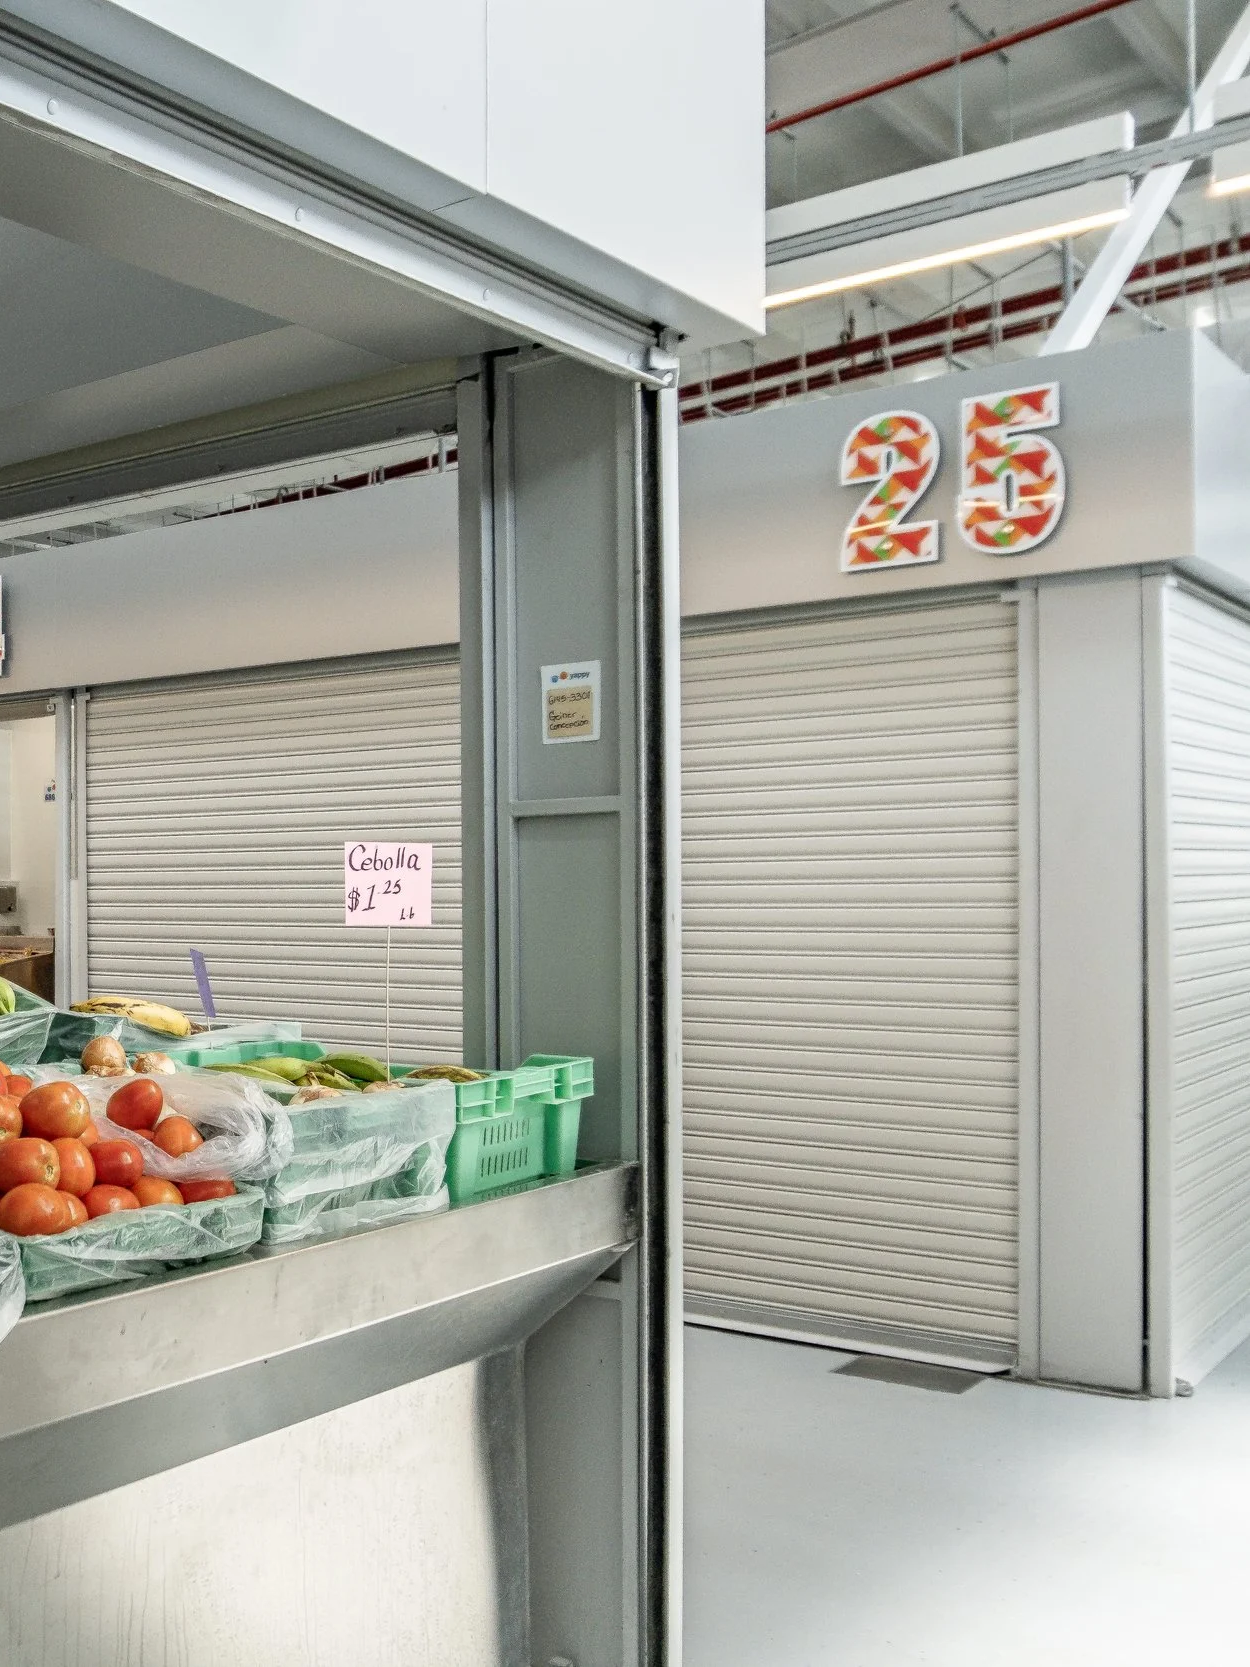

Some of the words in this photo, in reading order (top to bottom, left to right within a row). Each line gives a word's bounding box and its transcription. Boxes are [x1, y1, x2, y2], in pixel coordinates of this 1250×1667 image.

[841, 381, 1066, 572] 25
[569, 671, 591, 681] yappy
[348, 844, 421, 872] Cebolla
